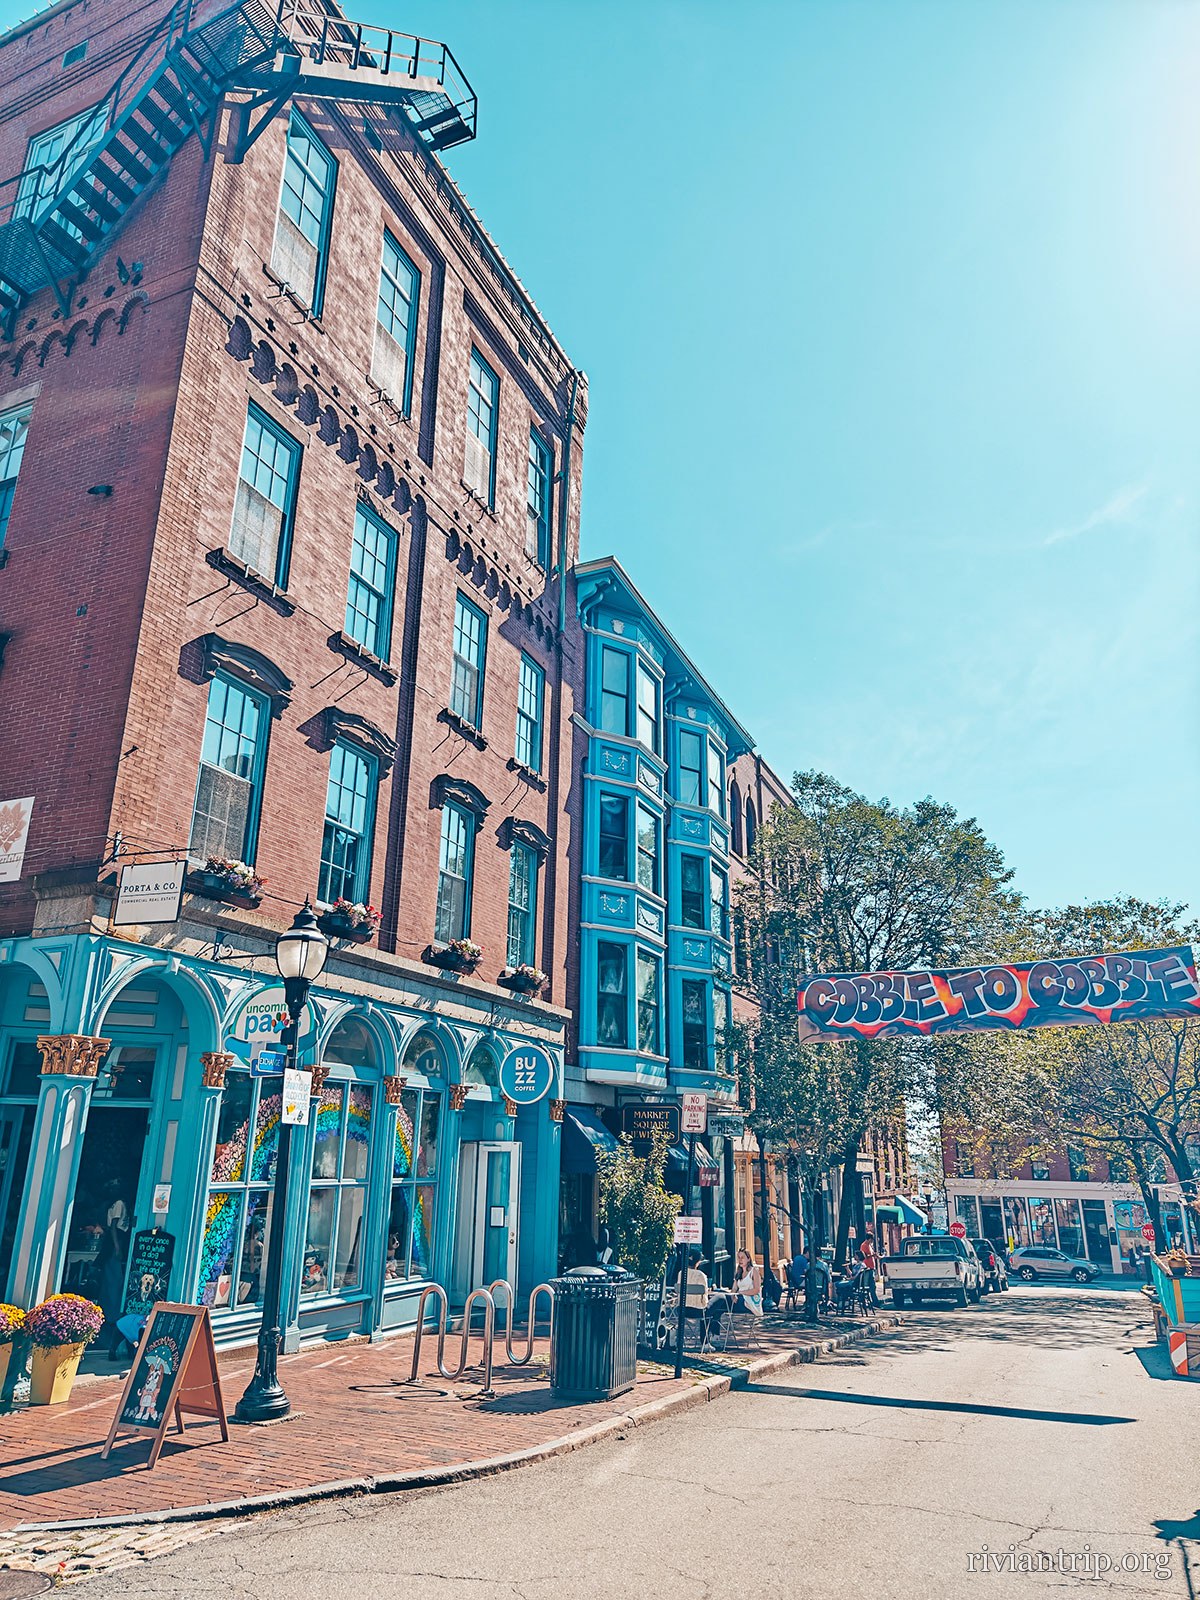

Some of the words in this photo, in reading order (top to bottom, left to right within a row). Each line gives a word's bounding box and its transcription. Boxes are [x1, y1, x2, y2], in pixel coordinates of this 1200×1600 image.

[123, 884, 151, 893] PORTA
[153, 883, 161, 891] &
[162, 882, 178, 890] CO.
[803, 972, 950, 1026] COBBLE
[946, 966, 1023, 1019] TO
[1026, 955, 1199, 1009] COBBLE
[246, 1003, 287, 1014] uncomm
[515, 1057, 537, 1071] BU
[514, 1071, 536, 1084] ZZ
[690, 1096, 700, 1104] NO
[684, 1104, 705, 1113] PARKING
[633, 1111, 670, 1119] MARKET
[633, 1120, 670, 1130] SQUARE
[950, 1226, 965, 1234] STOP
[1142, 1228, 1155, 1236] STO
[147, 1251, 160, 1260] dog
